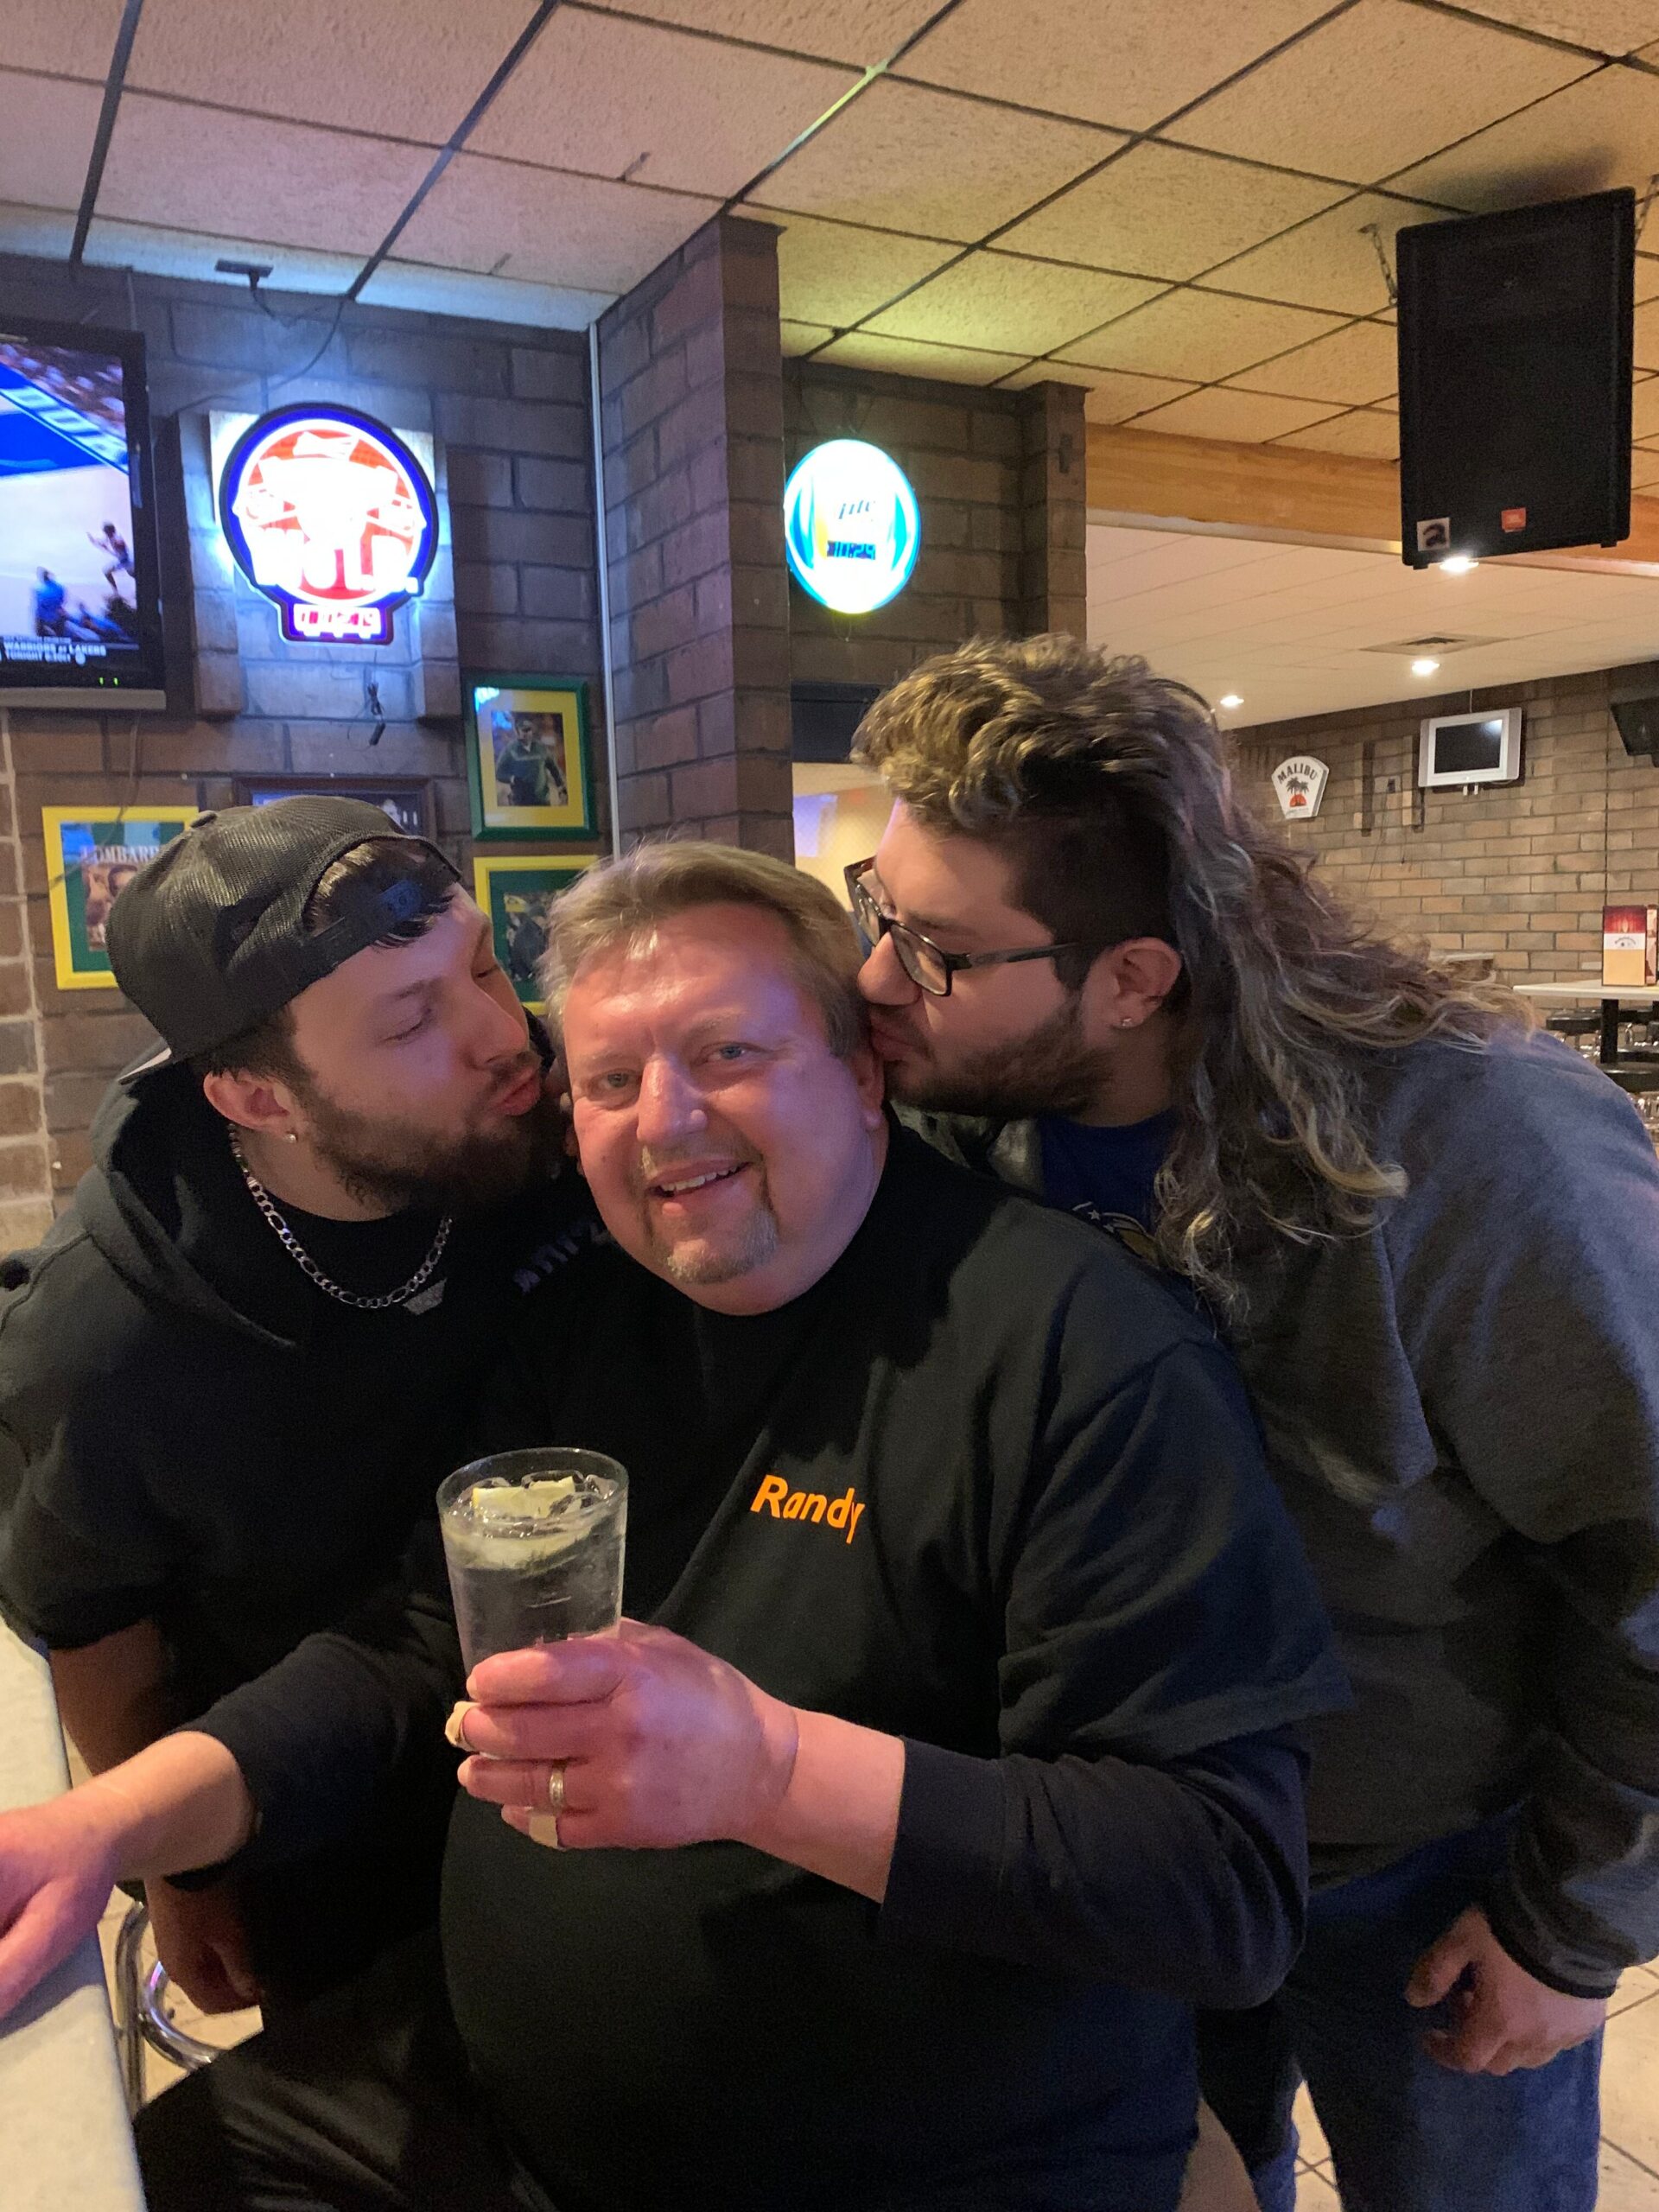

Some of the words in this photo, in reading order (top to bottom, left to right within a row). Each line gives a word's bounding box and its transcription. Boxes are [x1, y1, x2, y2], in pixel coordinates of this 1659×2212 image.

[3, 642, 56, 652] WARRIORS
[69, 644, 106, 656] LAKERS
[1277, 763, 1318, 785] MALIBU
[750, 1474, 866, 1545] Randy
